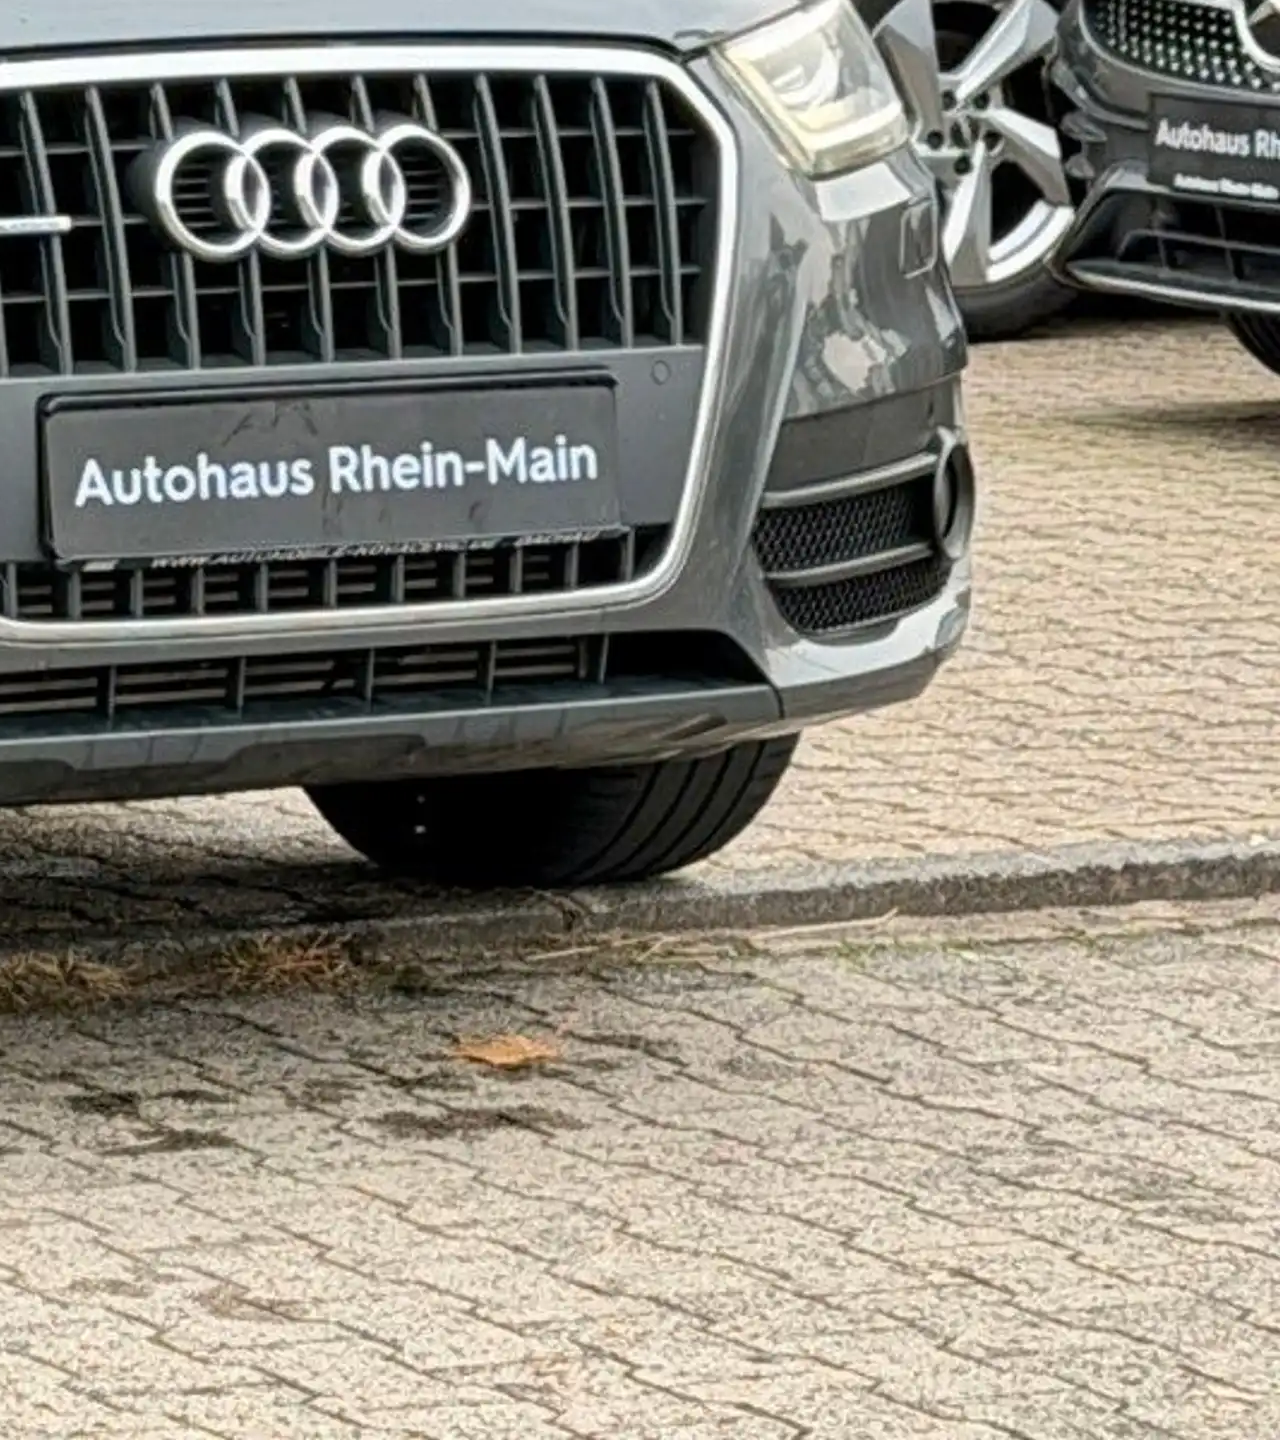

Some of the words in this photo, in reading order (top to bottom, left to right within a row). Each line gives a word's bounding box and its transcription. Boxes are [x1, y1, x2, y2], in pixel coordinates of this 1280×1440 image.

[1154, 117, 1251, 158] Autohaus
[74, 452, 315, 509] Autohaus
[327, 433, 599, 495] Rhein-Main
